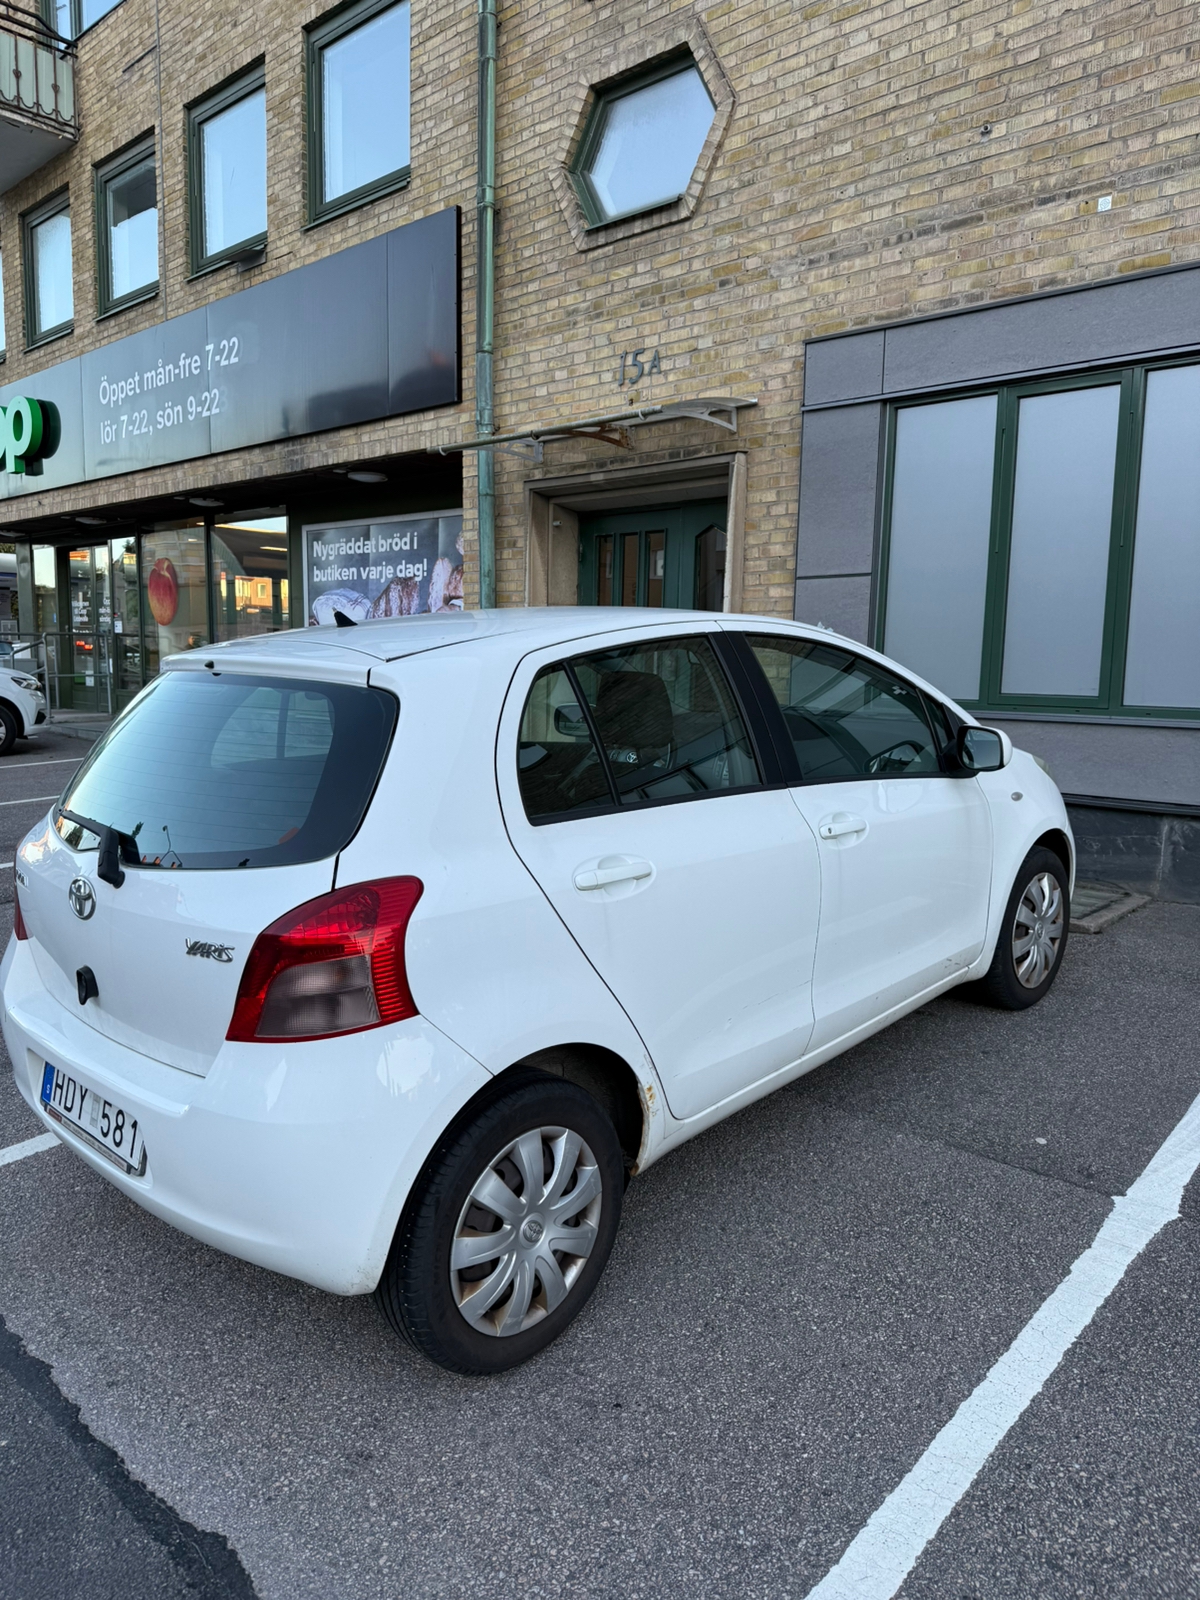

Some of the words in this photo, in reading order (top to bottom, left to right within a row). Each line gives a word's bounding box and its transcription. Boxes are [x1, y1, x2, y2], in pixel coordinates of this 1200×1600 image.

[99, 375, 140, 408] Öppet
[143, 352, 201, 391] mån-fre
[205, 336, 239, 370] 7-22
[618, 347, 661, 386] 15A
[100, 420, 117, 444] lör
[120, 409, 152, 438] 7-22,
[156, 401, 183, 429] sön
[187, 388, 220, 420] 9-22
[313, 537, 376, 560] Nygräddat
[378, 532, 411, 553] bröd
[413, 531, 418, 550] i
[313, 564, 358, 582] butiken
[360, 561, 394, 583] varje
[396, 558, 428, 582] dag!
[53, 1069, 89, 1121] HDY
[100, 1099, 138, 1158] 581
